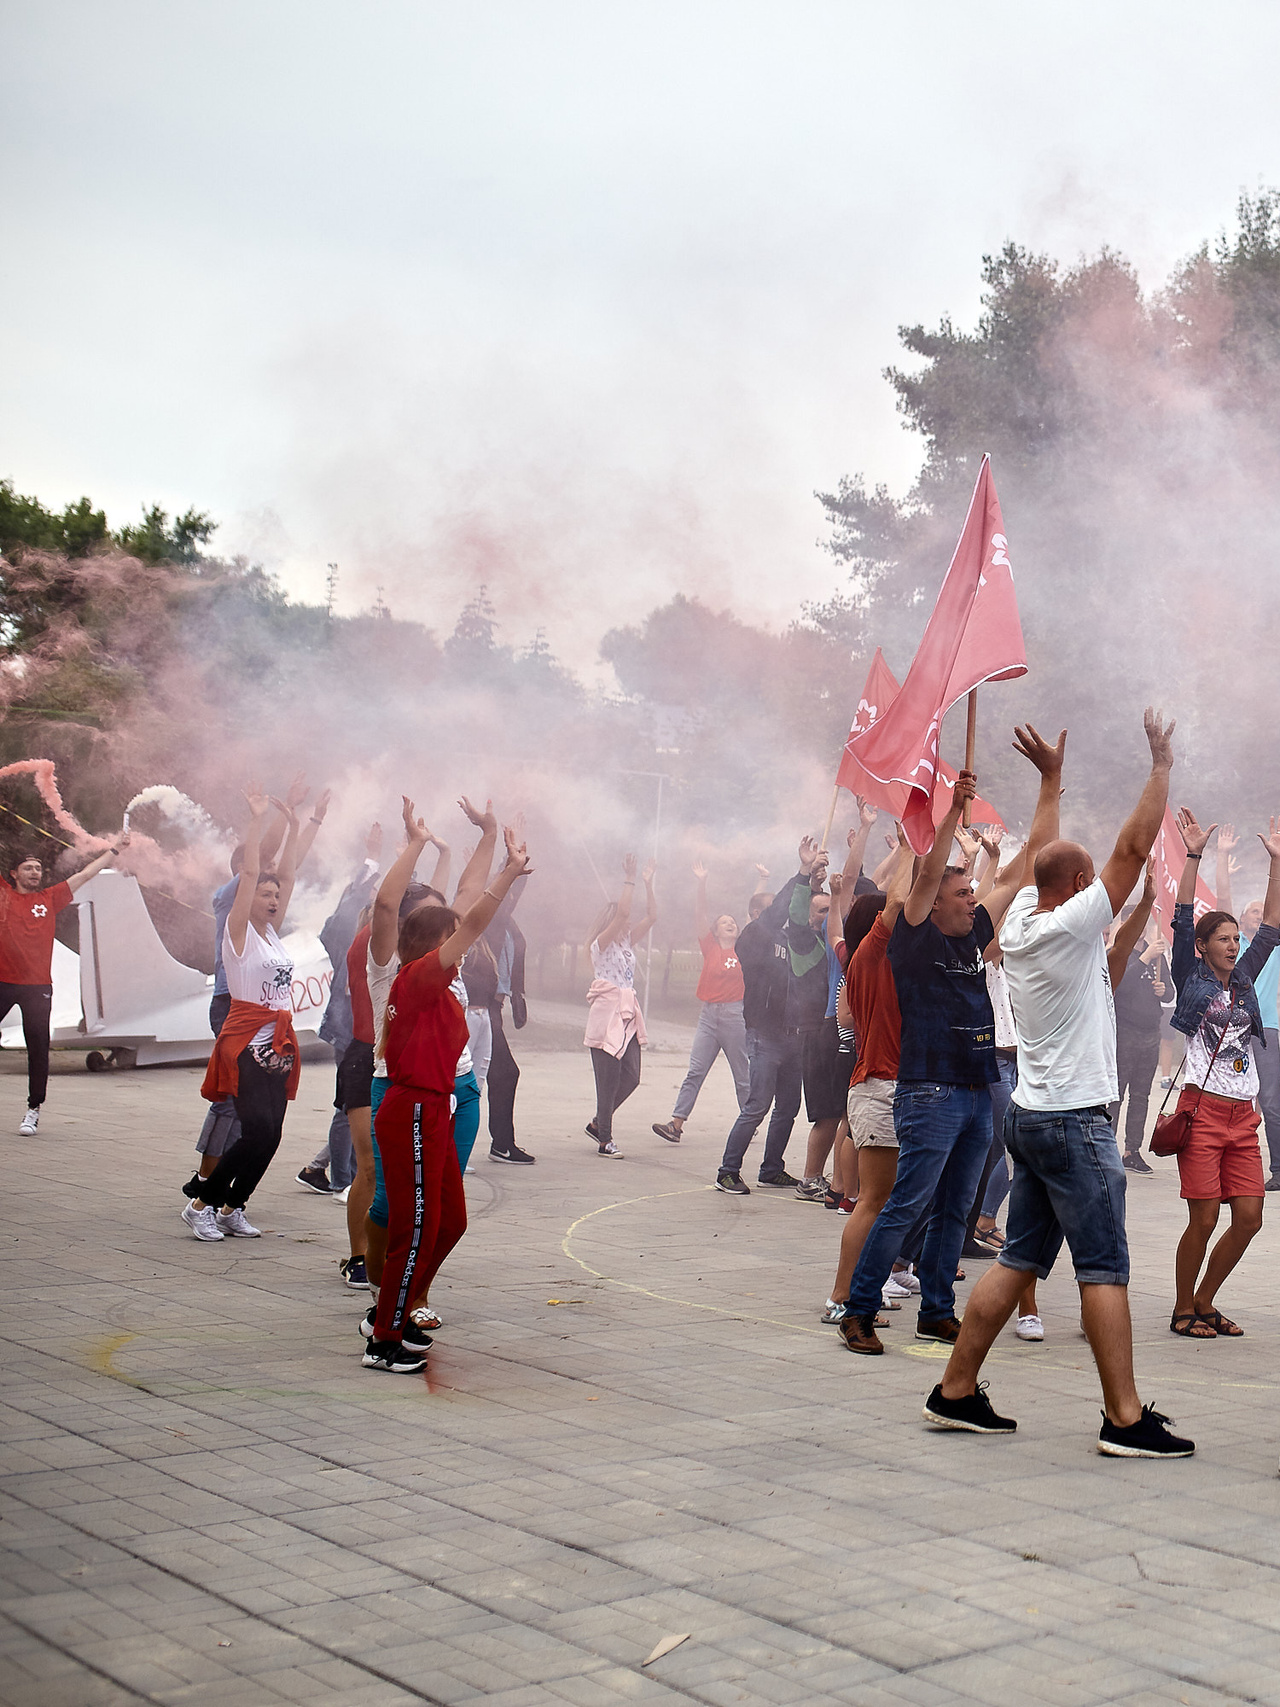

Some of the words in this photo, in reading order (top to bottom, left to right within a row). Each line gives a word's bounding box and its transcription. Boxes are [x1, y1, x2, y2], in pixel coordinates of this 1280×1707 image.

[413, 1121, 423, 1162] adidas
[415, 1186, 425, 1226] adidas
[401, 1249, 417, 1287] adidas
